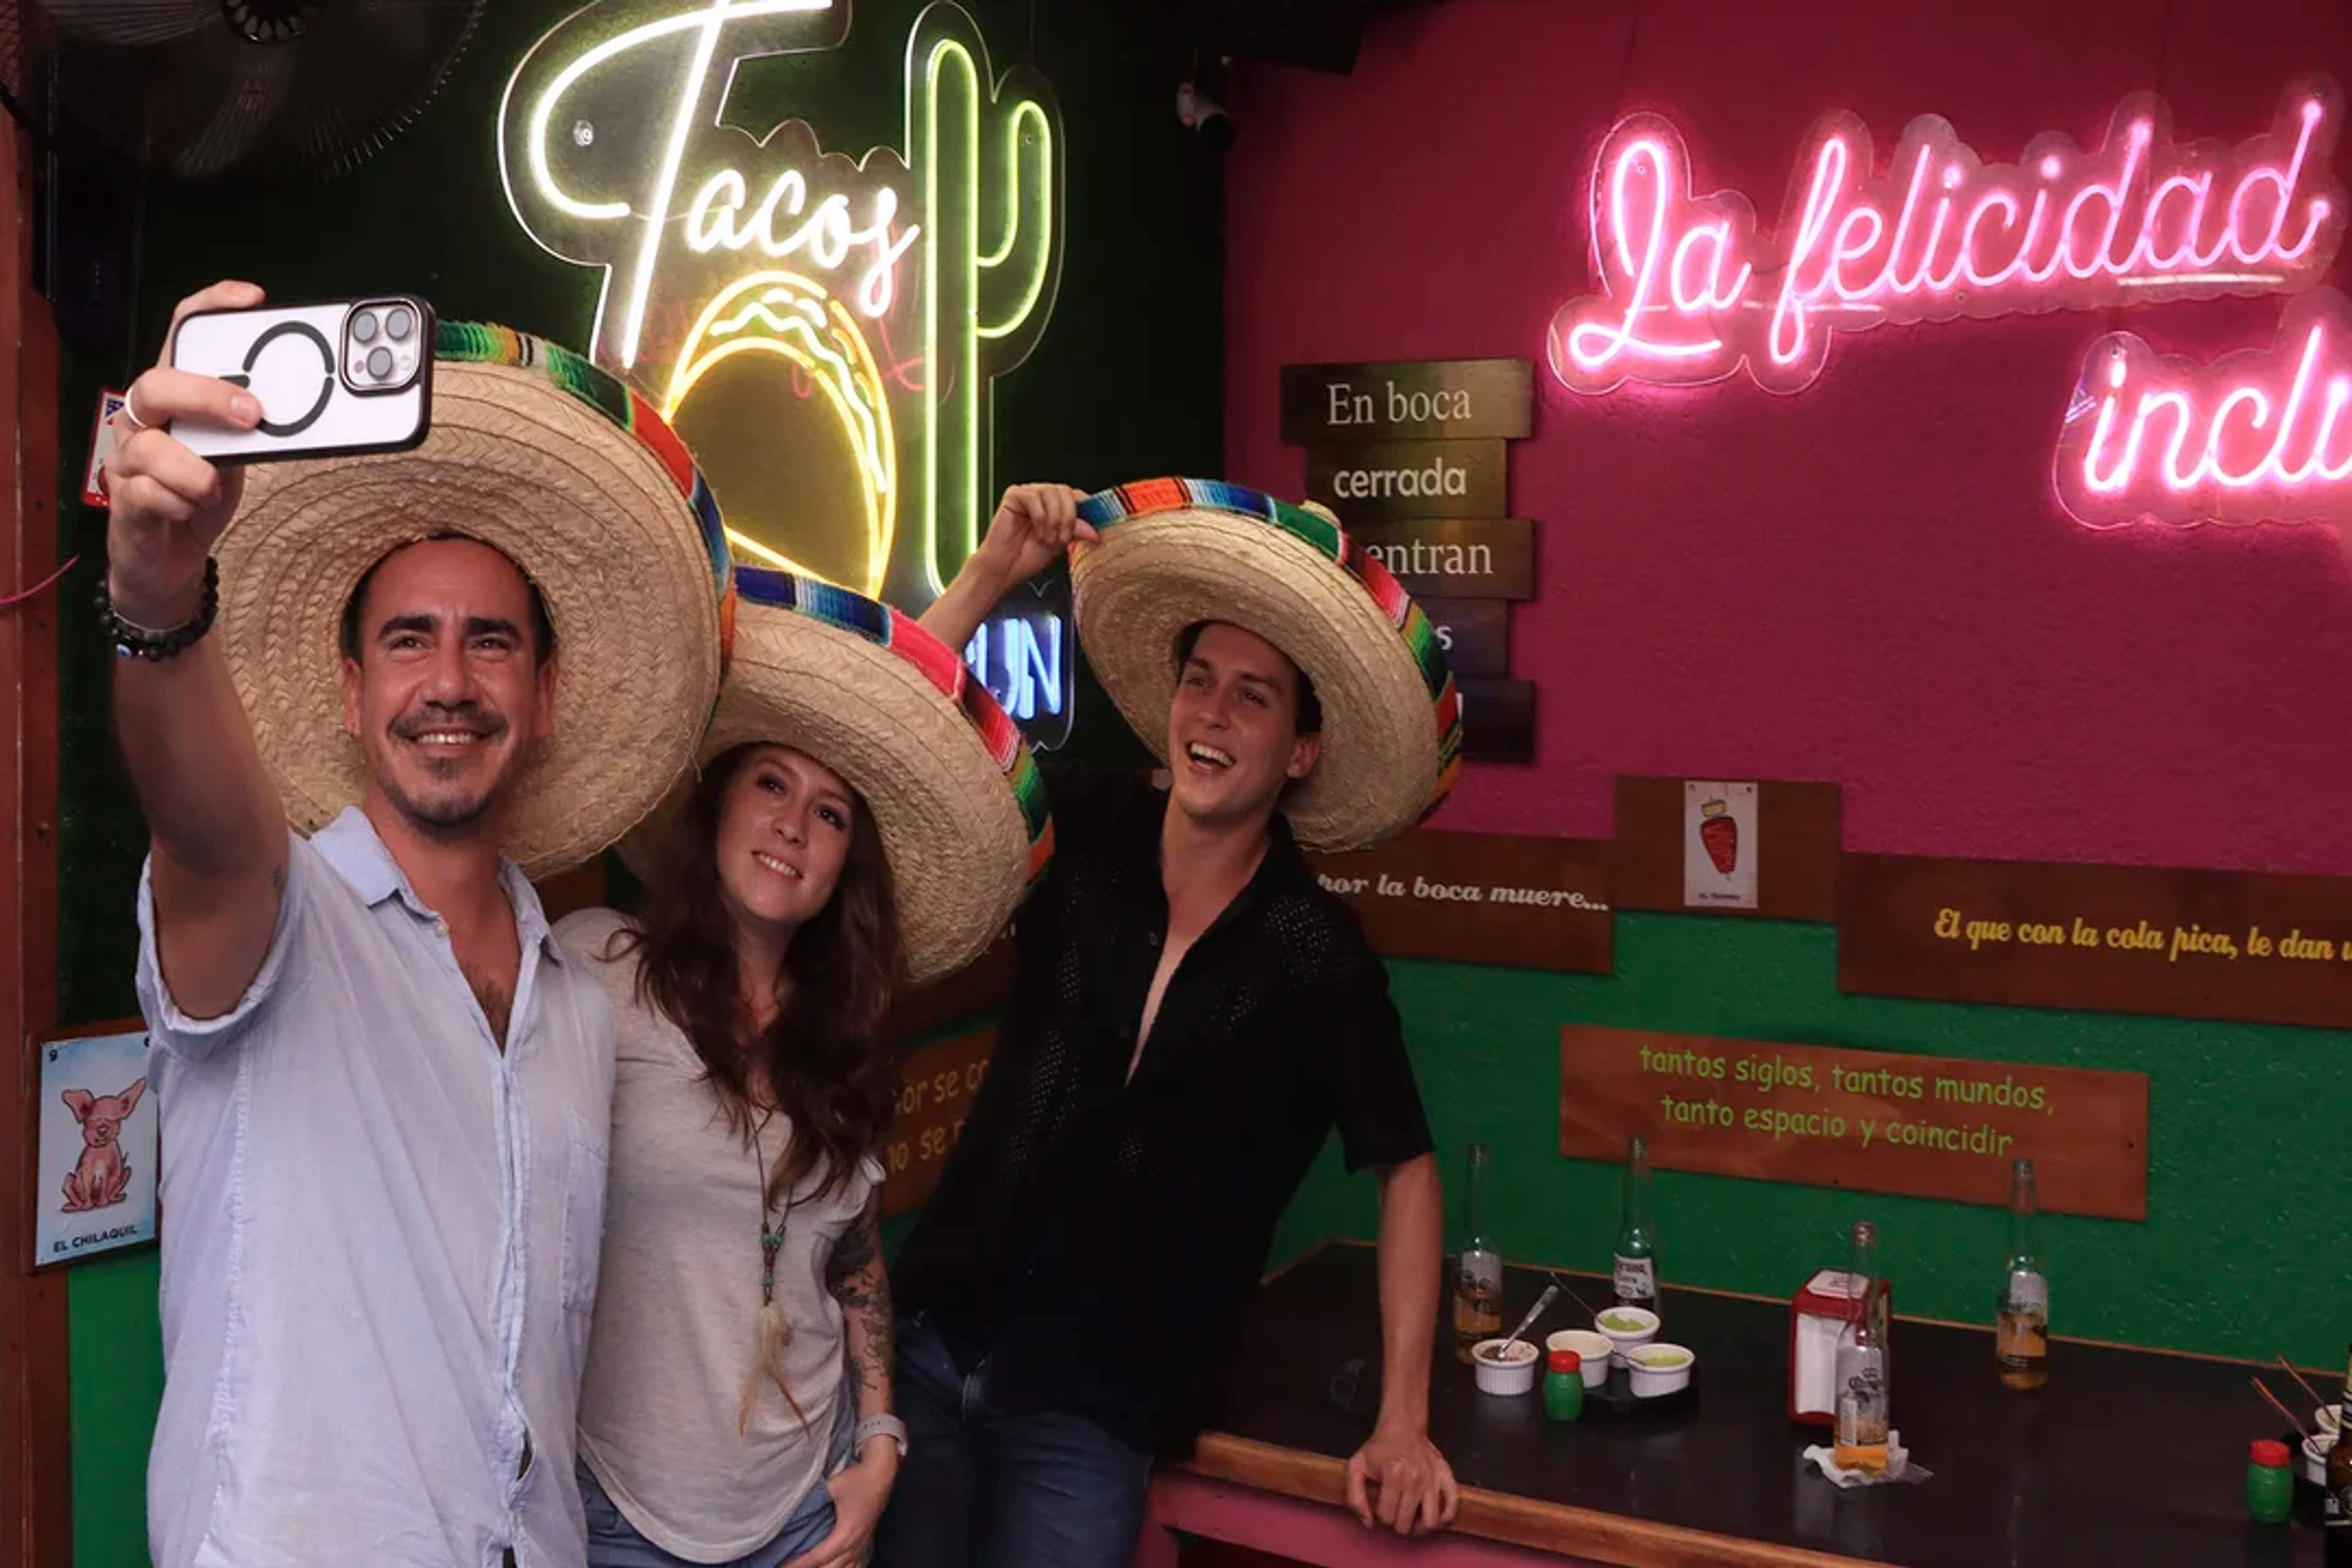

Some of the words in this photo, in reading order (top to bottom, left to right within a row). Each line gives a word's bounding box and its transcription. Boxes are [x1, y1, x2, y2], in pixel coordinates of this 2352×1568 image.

[529, 0, 920, 369] Tacos
[1569, 140, 1751, 365] La
[1769, 101, 2331, 364] felicidad
[1327, 383, 1374, 425] En
[1386, 381, 1472, 423] boca
[1333, 457, 1467, 497] cerrada
[1376, 873, 1406, 896] la
[1413, 876, 1483, 900] boca
[1490, 885, 1608, 911] muere...
[1934, 909, 1960, 938] El
[1966, 919, 2011, 949] que
[2018, 922, 2065, 945] con
[2072, 918, 2097, 946] la
[2106, 921, 2164, 949] cola
[2169, 924, 2239, 961] pica,
[2247, 927, 2272, 956] le
[2279, 930, 2334, 959] dan
[934, 1071, 959, 1103] se
[1639, 1045, 1727, 1080] tantos
[1735, 1055, 1821, 1093] siglos,
[1832, 1064, 1924, 1099] tantos
[1936, 1076, 2054, 1115] mundos,
[1662, 1096, 1735, 1127] tanto
[1743, 1107, 1846, 1140] espacio
[1859, 1117, 1877, 1148] y
[1887, 1120, 2013, 1156] coincidir
[53, 1240, 69, 1253] EL
